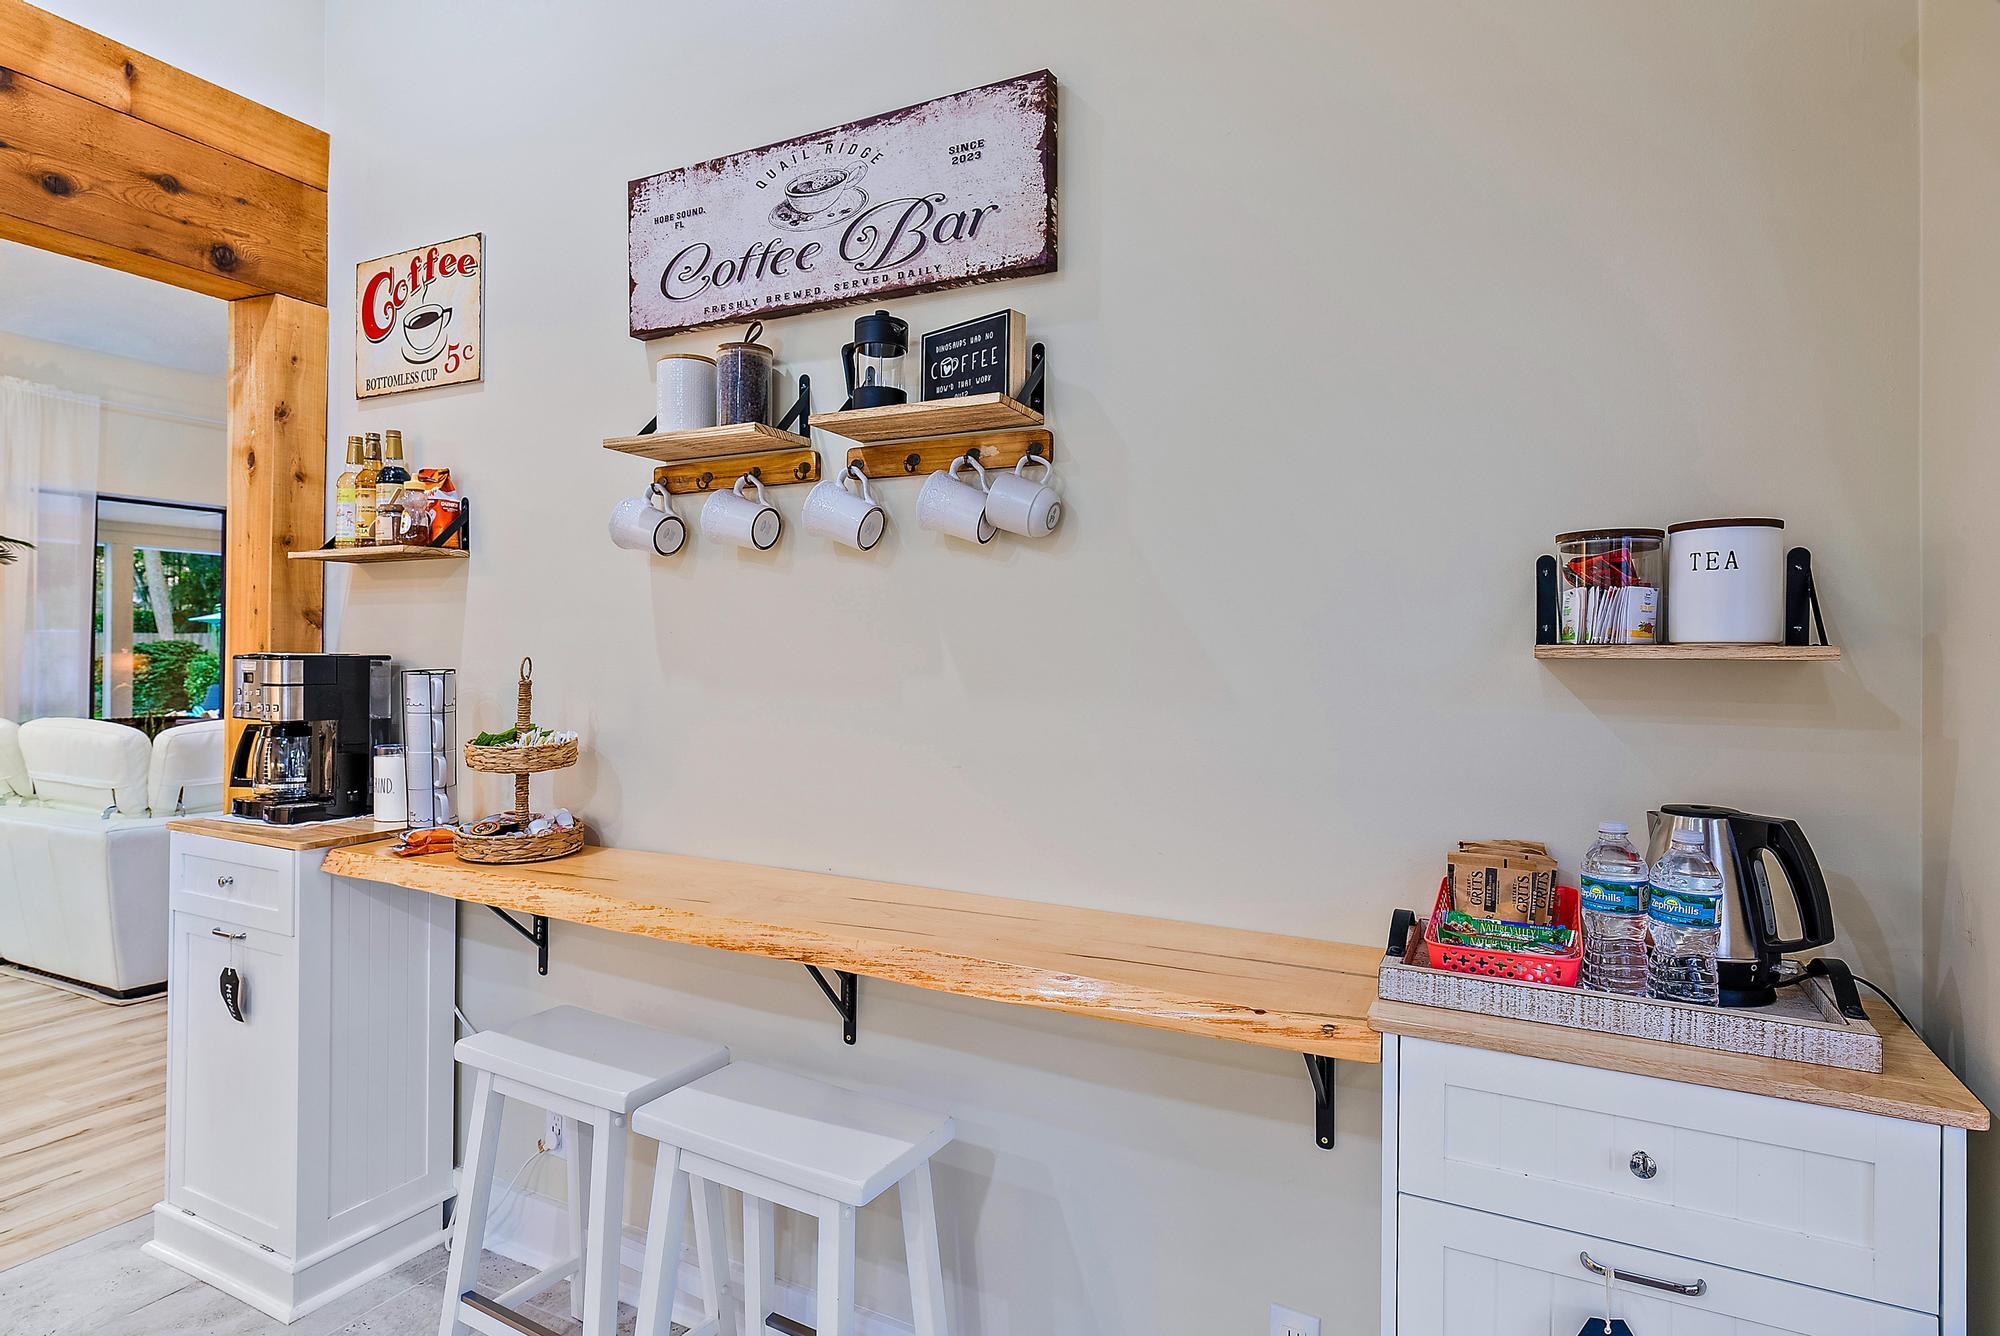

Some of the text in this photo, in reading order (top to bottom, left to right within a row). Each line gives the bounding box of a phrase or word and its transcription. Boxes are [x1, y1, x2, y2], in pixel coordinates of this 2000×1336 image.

[948, 138, 985, 155] SINCE
[755, 142, 884, 190] QUAIL RIDGE
[951, 150, 982, 165] 2023
[653, 213, 675, 225] HOBE
[674, 220, 685, 230] FL
[660, 192, 999, 301] Coffee Bar
[361, 246, 478, 342] Coffee
[703, 297, 759, 315] FRESHLY
[834, 274, 889, 292] SERVED
[897, 264, 942, 280] DAILY
[984, 331, 994, 341] NO
[365, 367, 438, 391] BOTTOMLESS CUP
[975, 374, 992, 385] WORK
[1689, 550, 1740, 571] TEA
[1470, 870, 1484, 906] GRITS
[1517, 875, 1530, 914] GRITS
[1535, 871, 1550, 909] GRITS
[1651, 897, 1700, 916] Zephyrhills
[1480, 922, 1508, 933] NATURE
